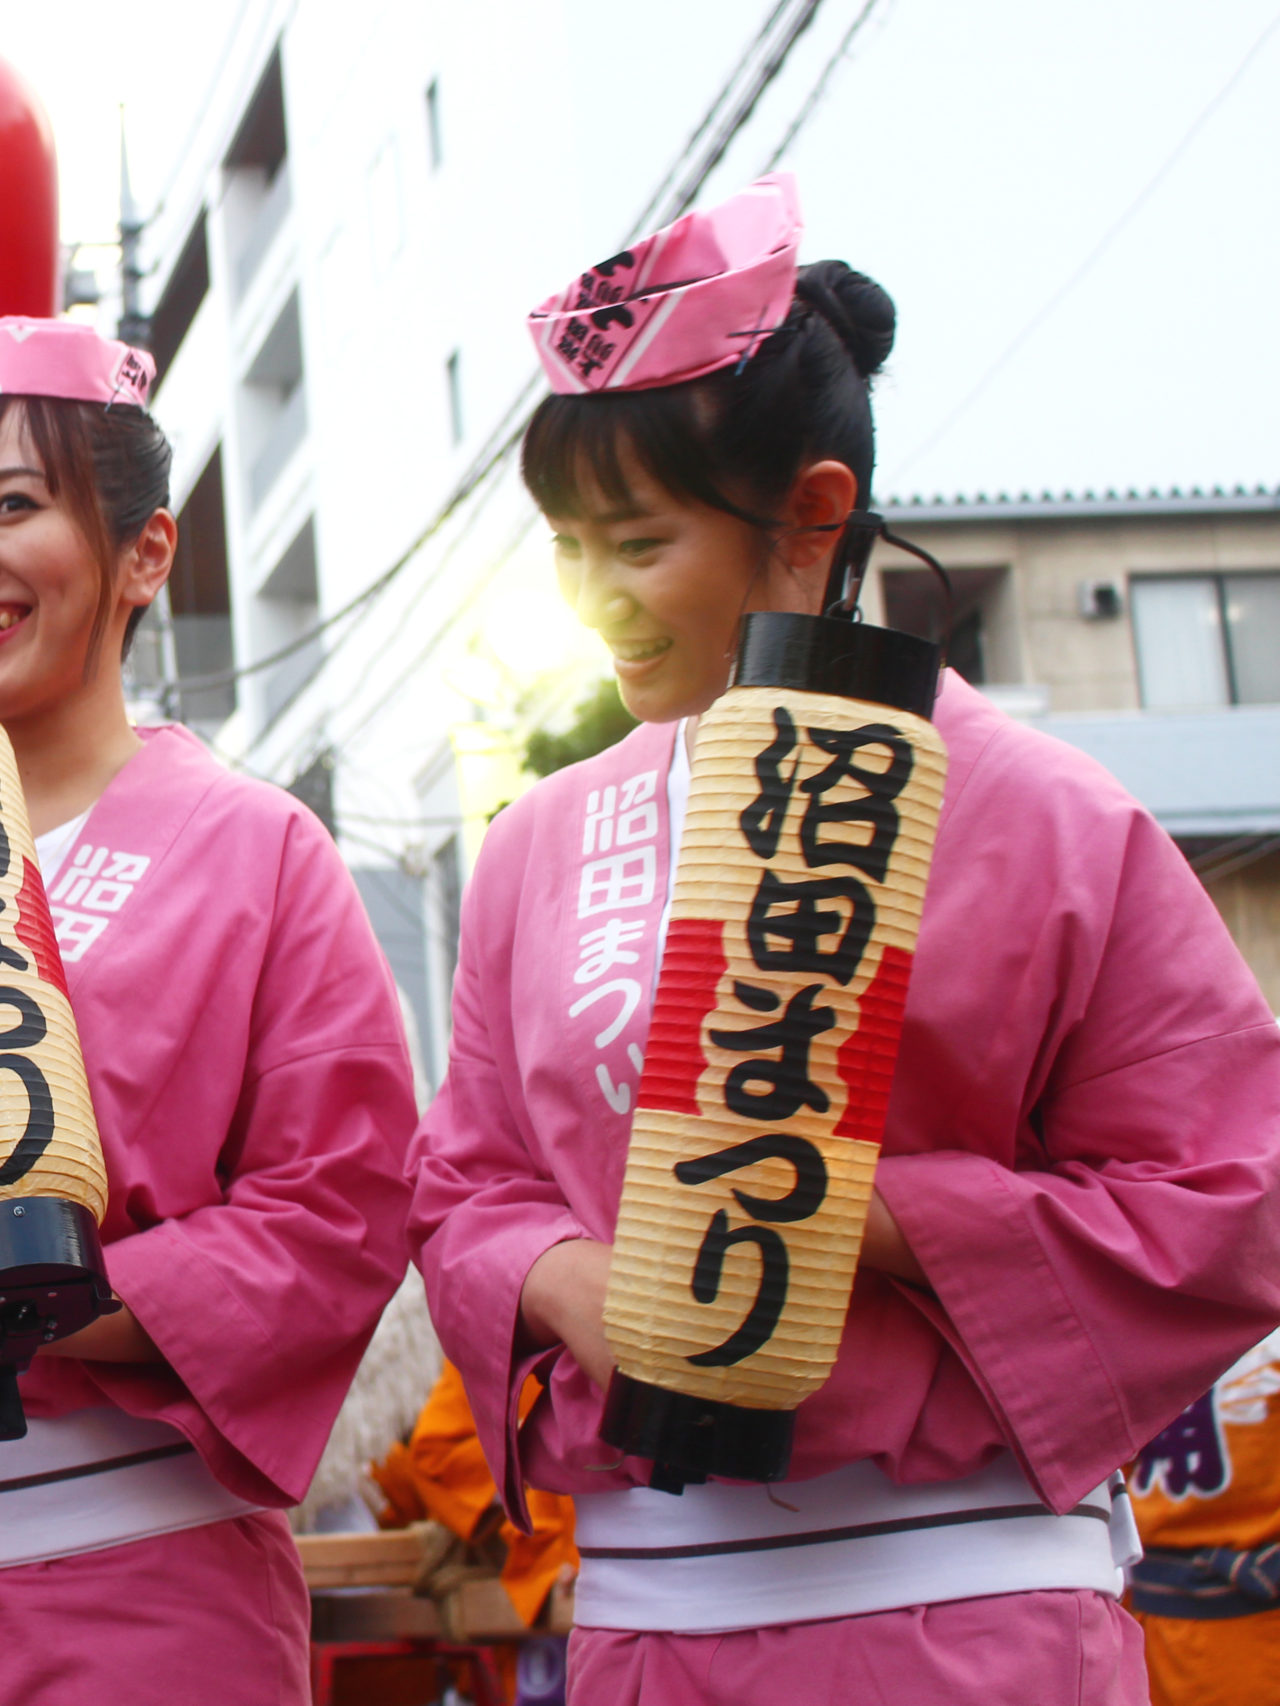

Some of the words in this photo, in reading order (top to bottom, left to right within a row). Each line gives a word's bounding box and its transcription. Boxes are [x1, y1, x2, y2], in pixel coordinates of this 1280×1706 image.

[673, 706, 915, 1368] 沼田まつり
